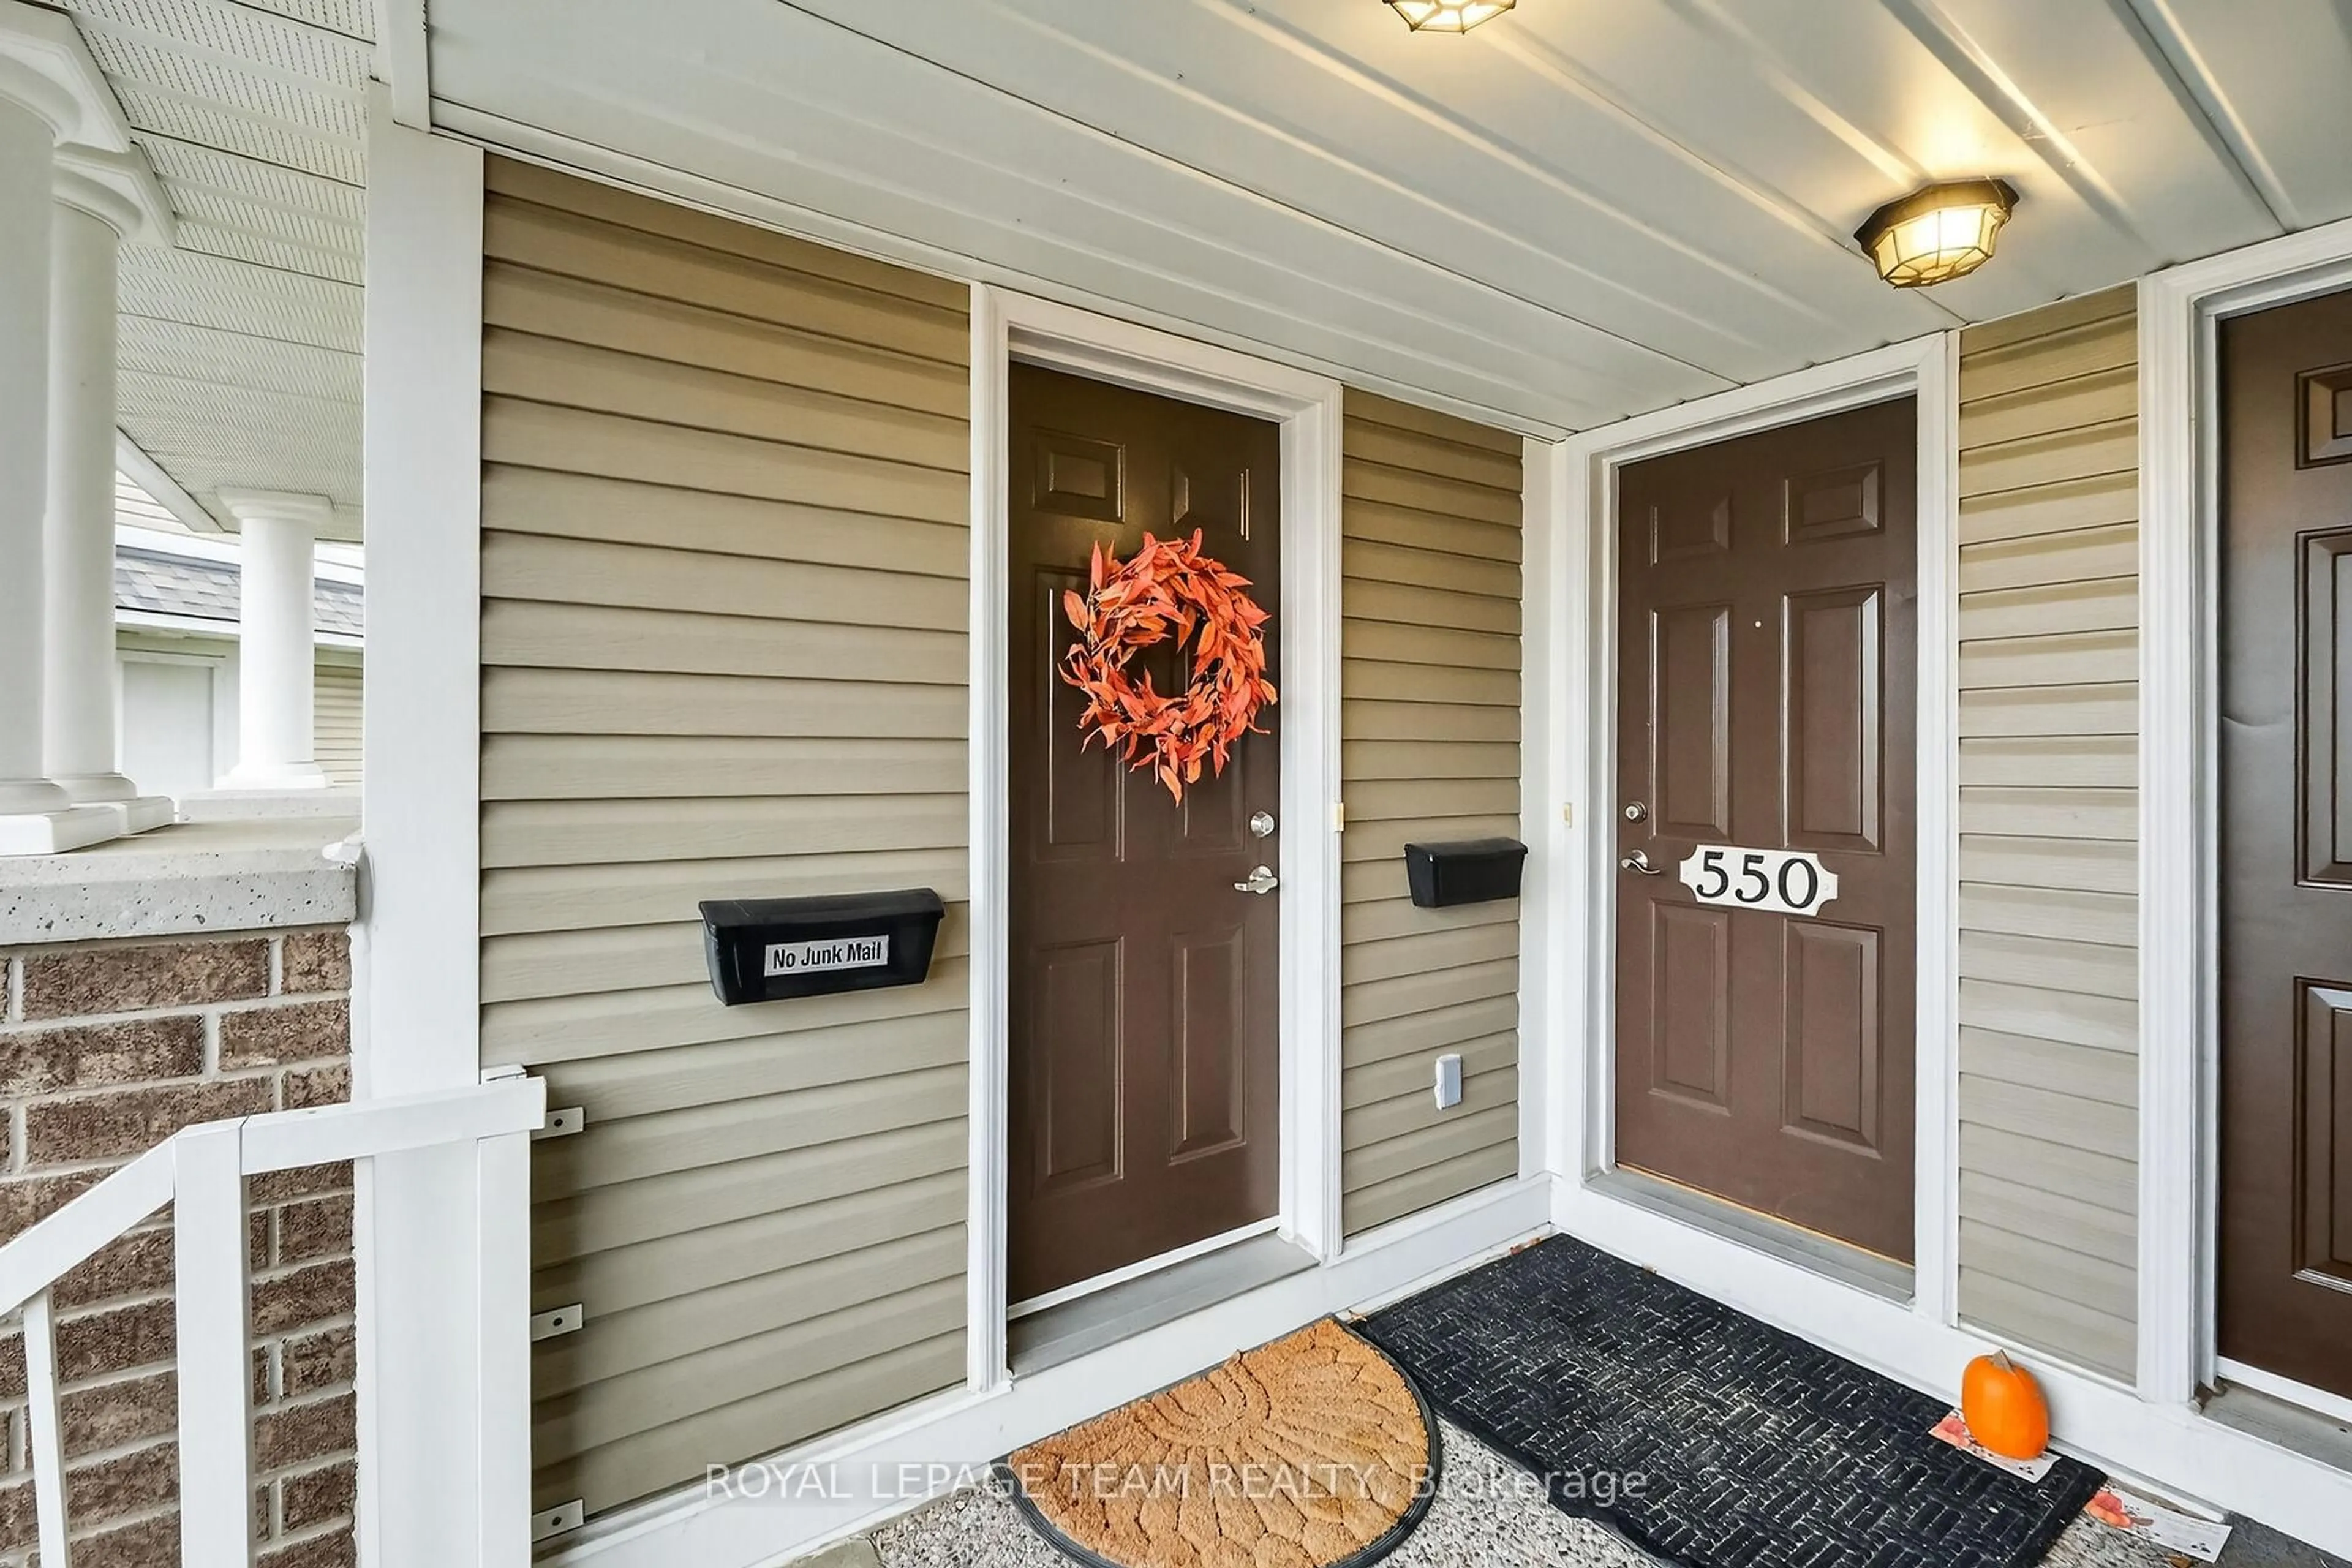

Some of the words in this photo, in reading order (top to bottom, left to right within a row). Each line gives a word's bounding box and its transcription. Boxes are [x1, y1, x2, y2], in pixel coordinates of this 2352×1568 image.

[1696, 851, 1818, 909] 550
[773, 949, 796, 970] No
[801, 944, 843, 967] Junk
[846, 941, 881, 962] Mail
